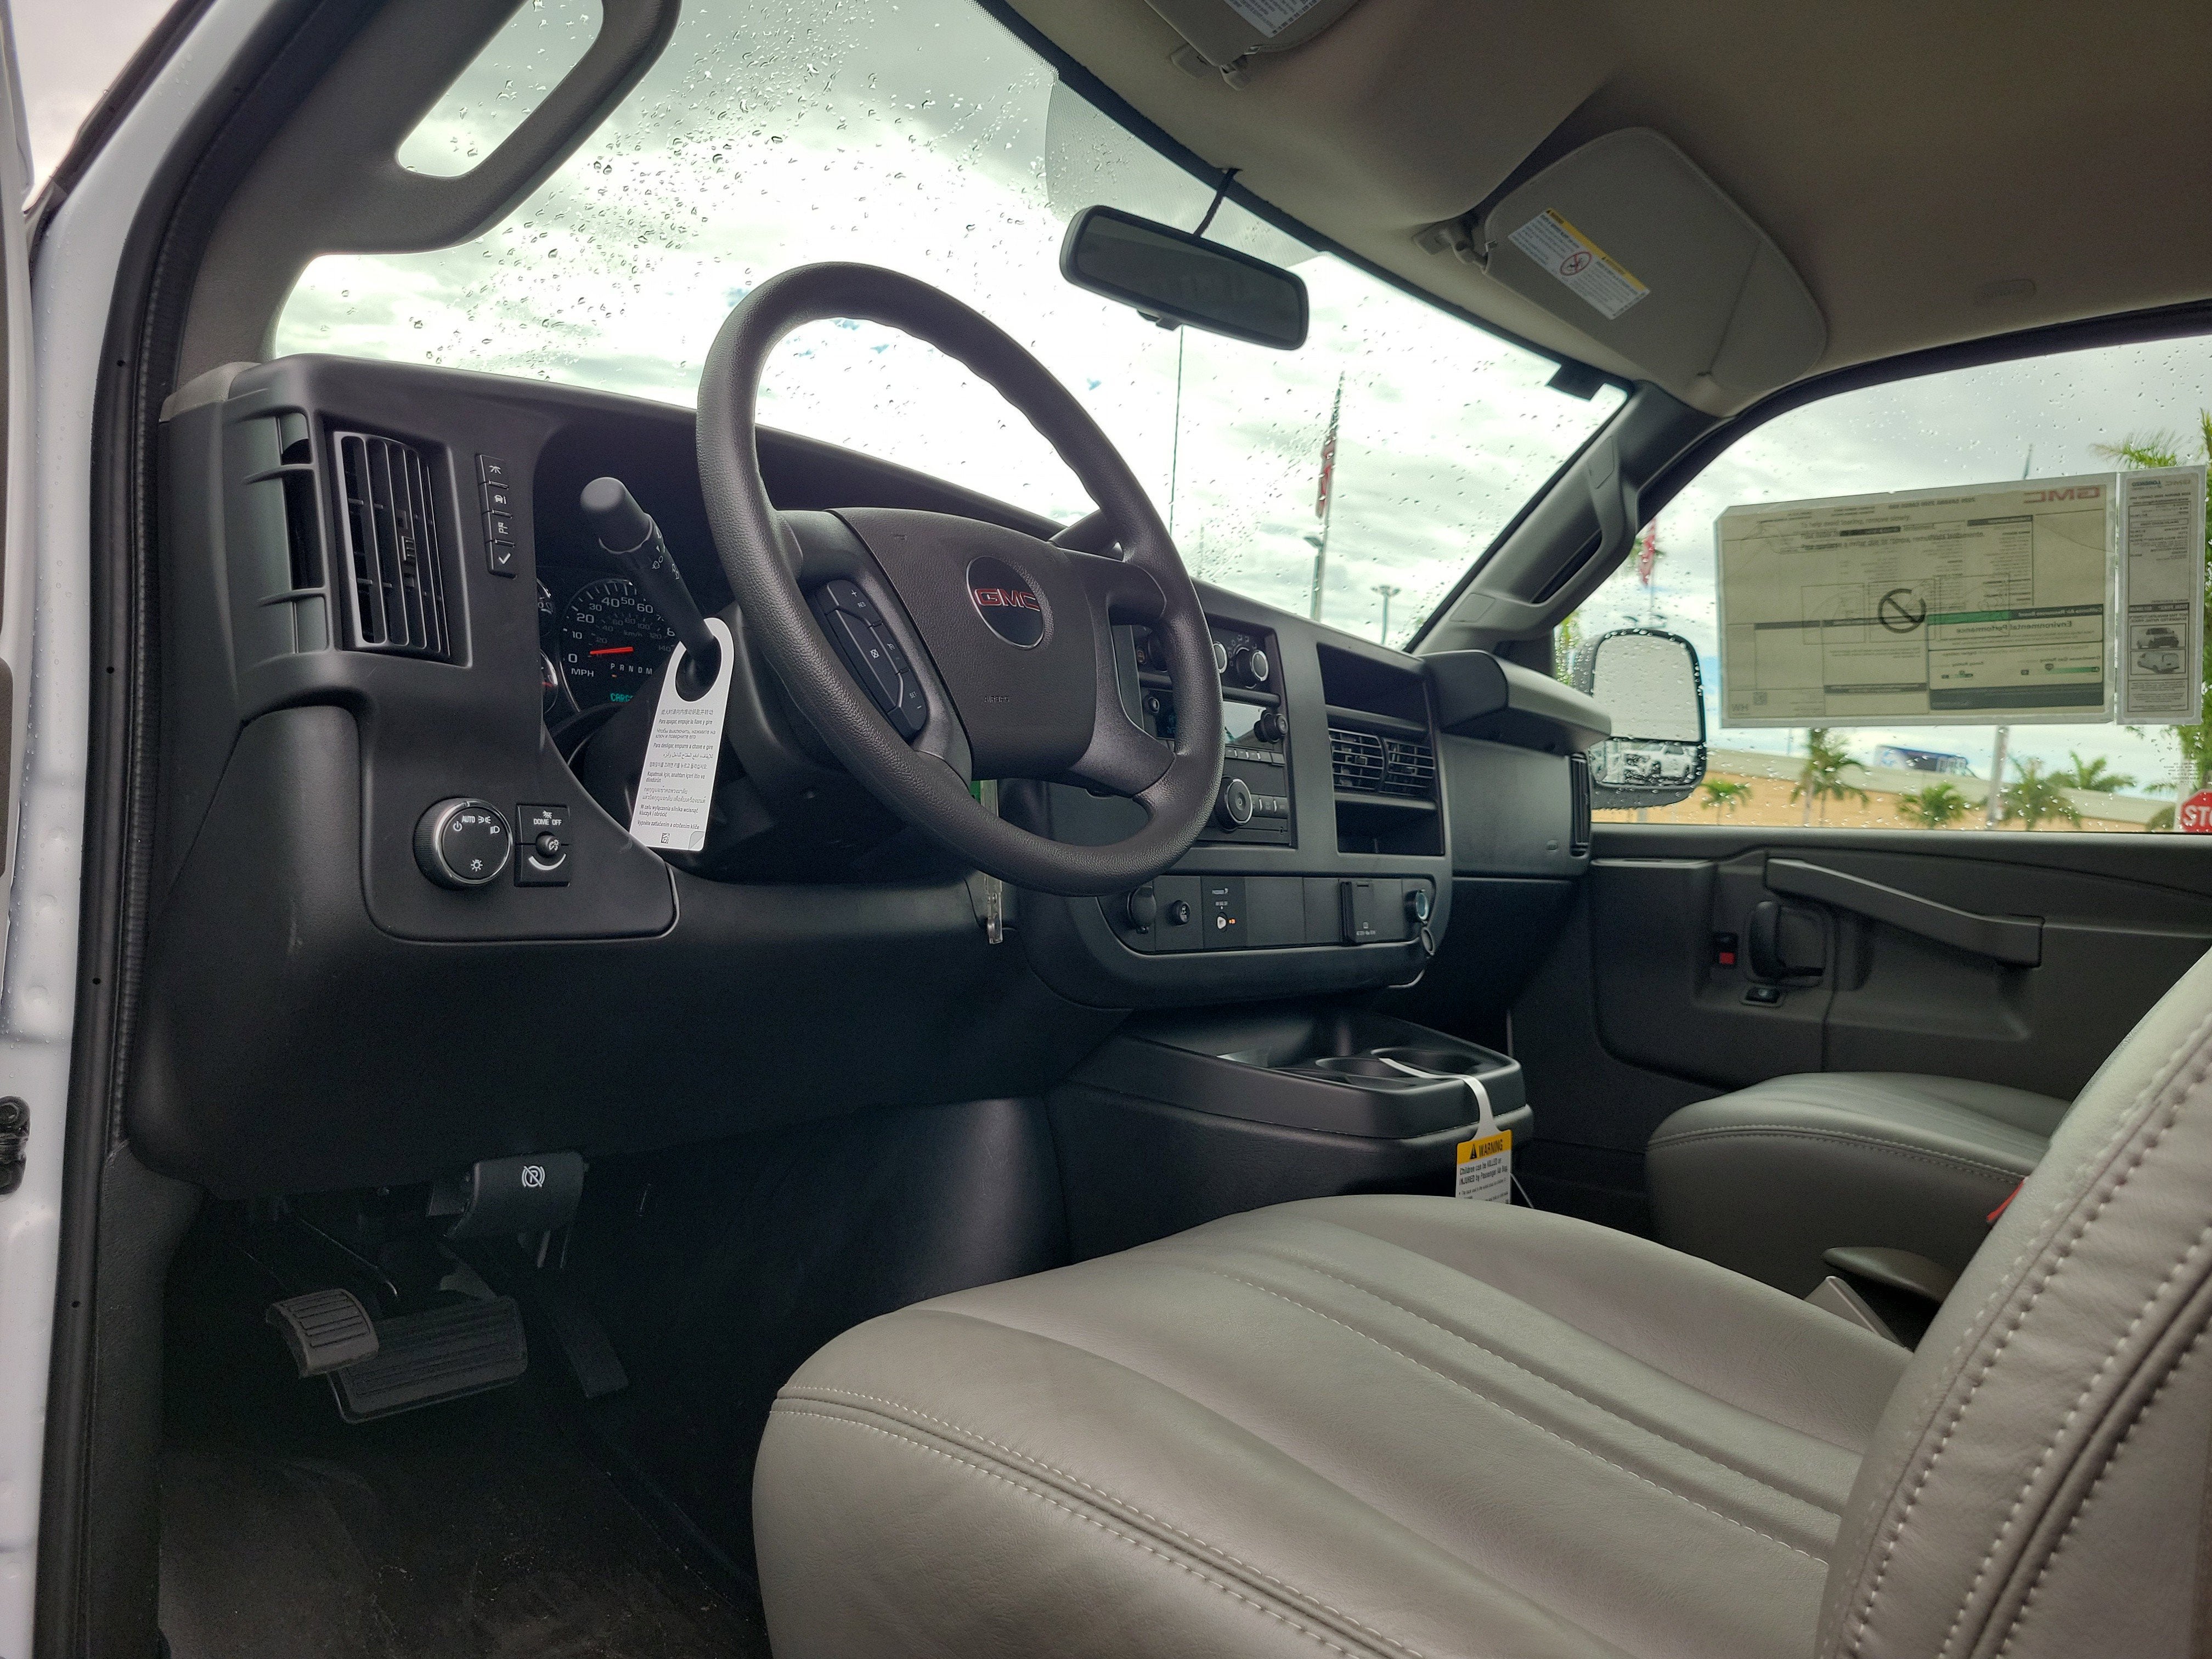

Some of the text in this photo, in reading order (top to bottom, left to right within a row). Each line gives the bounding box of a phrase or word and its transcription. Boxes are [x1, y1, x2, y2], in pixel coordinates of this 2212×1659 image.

[601, 597, 620, 608] 40
[621, 597, 635, 606] 50
[973, 588, 1040, 611] GMC
[637, 603, 653, 613] 60
[577, 613, 595, 623] 20
[572, 631, 583, 640] 10
[568, 653, 578, 663] 0
[571, 668, 594, 677] MPH
[610, 692, 634, 702] CARG
[1479, 1139, 1503, 1156] WARNING
[1460, 1166, 1475, 1175] Children
[1487, 1158, 1497, 1166] KILLED
[1459, 1175, 1475, 1185] INJURED
